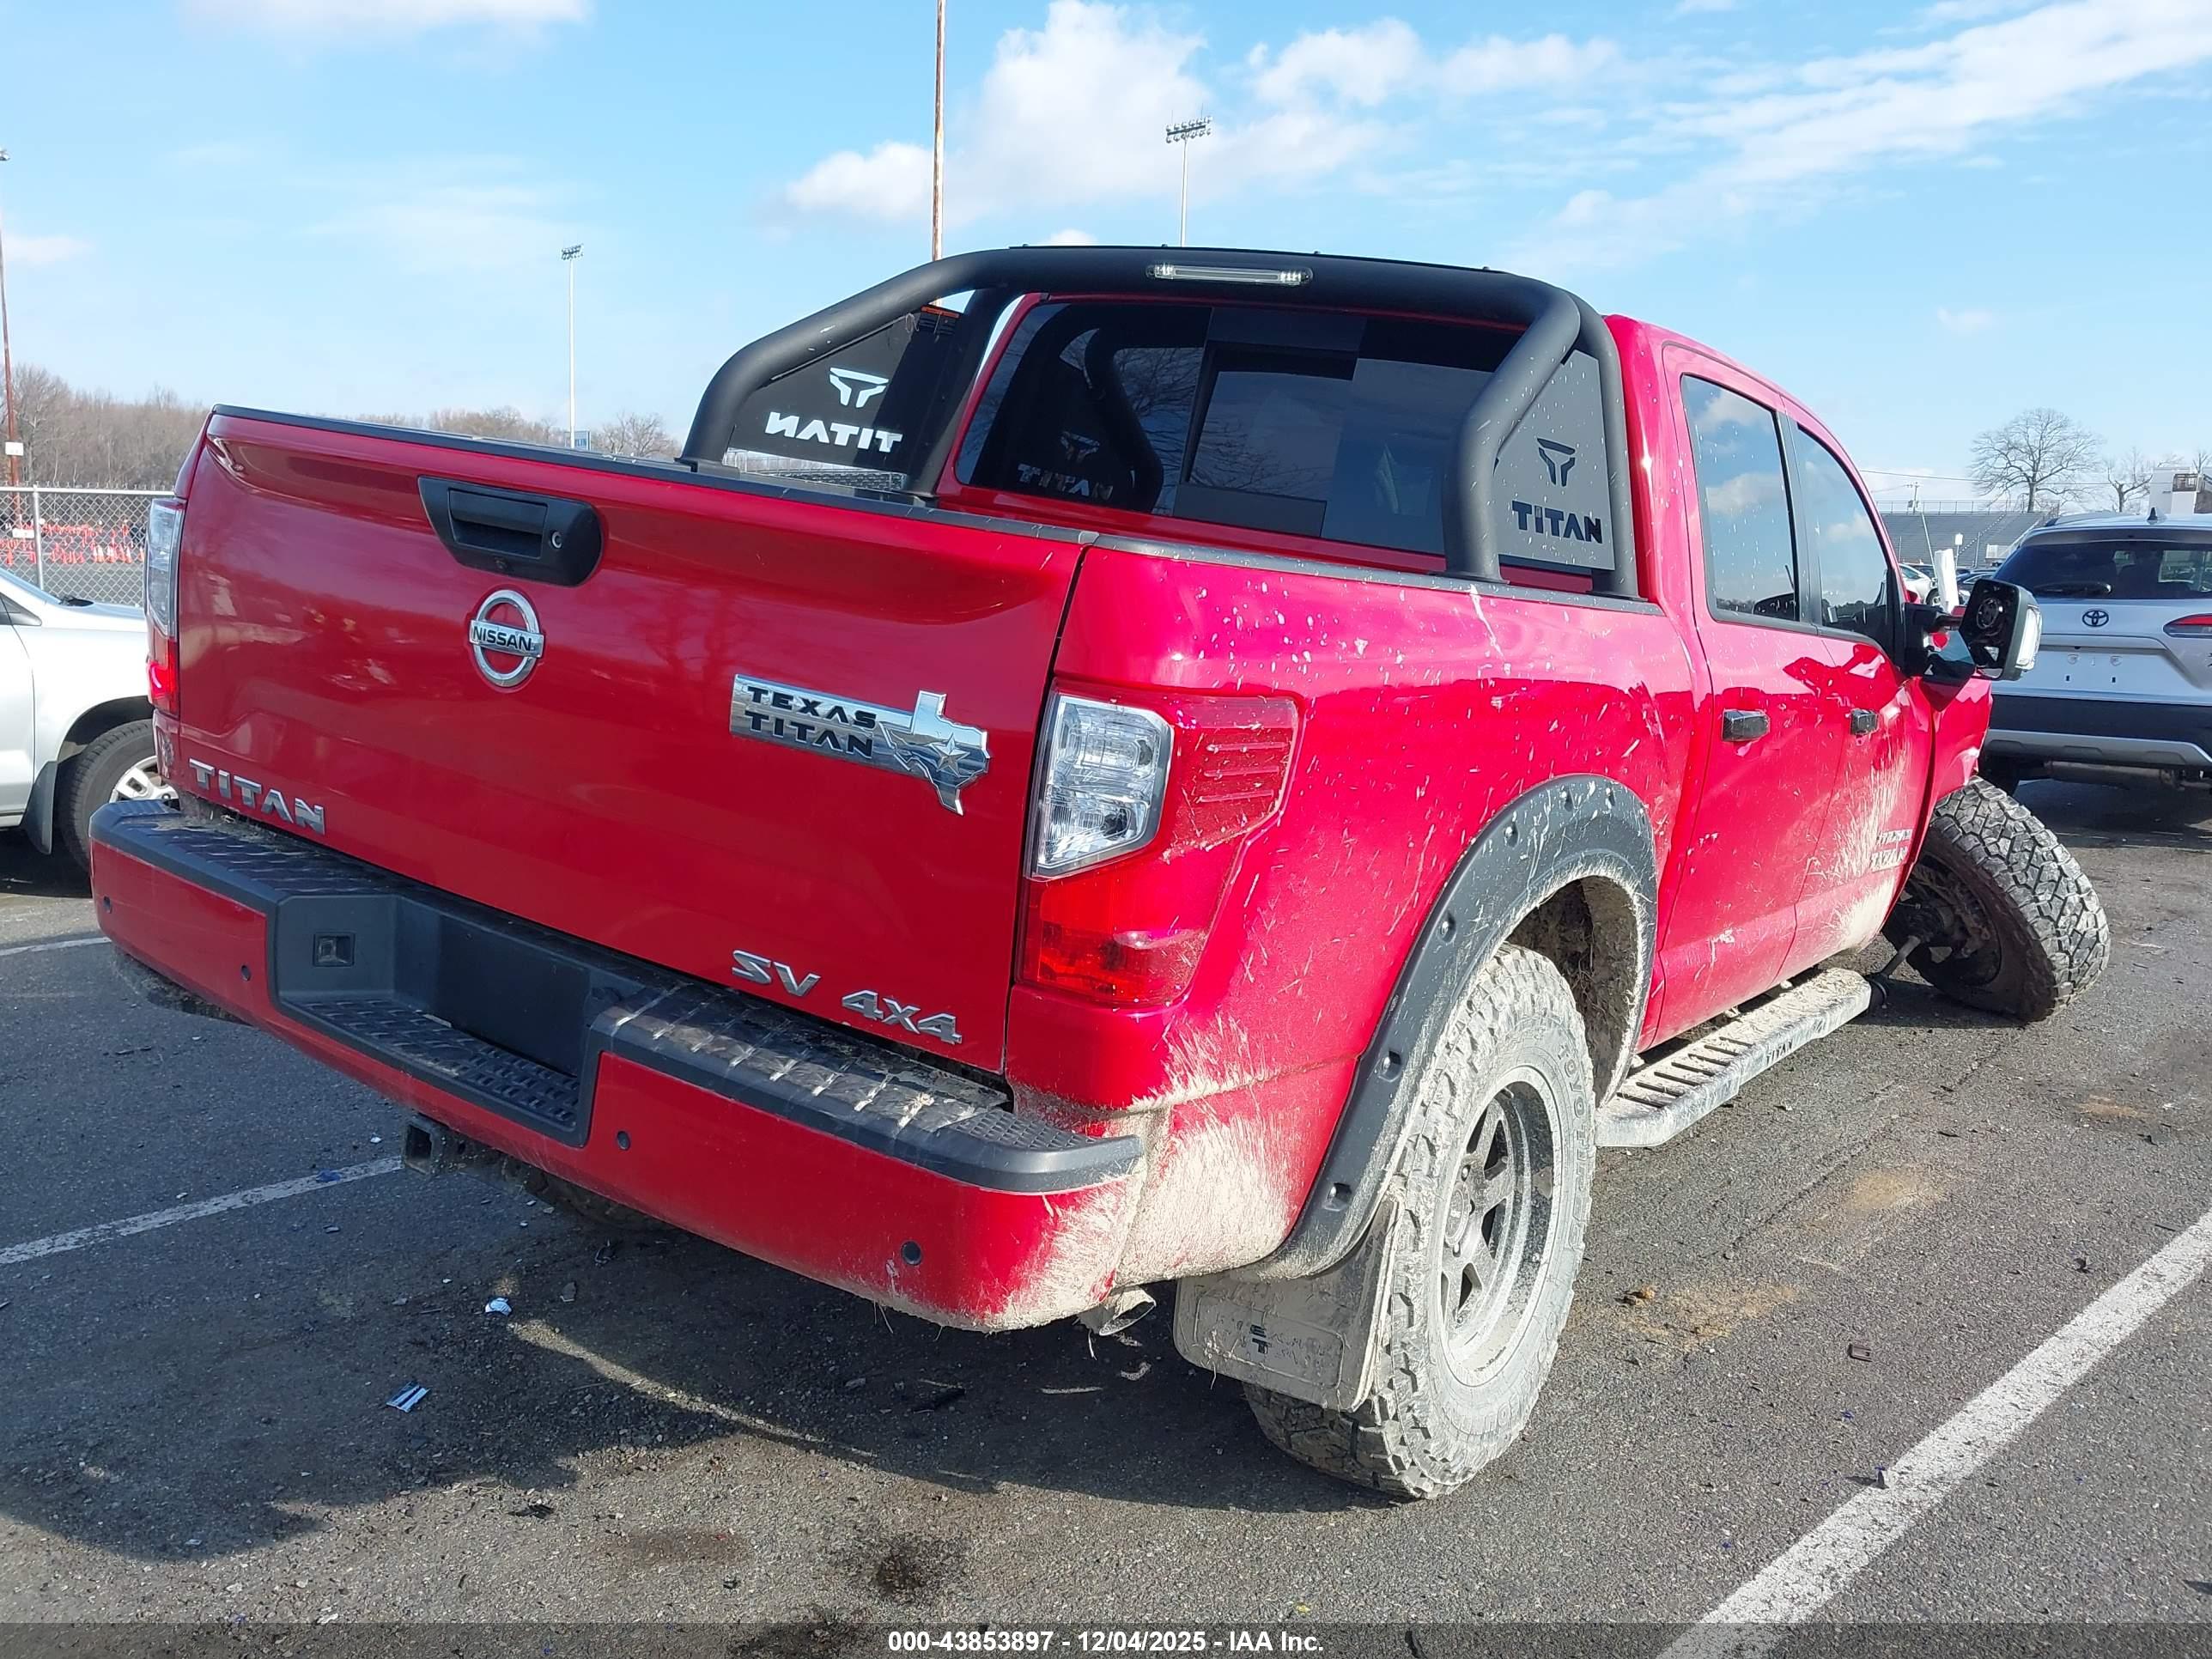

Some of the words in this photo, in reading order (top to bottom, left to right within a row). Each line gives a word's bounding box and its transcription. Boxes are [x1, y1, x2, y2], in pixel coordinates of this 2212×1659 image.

[1511, 500, 1602, 544] TITAN
[472, 625, 532, 651] NISSAN
[747, 686, 877, 729] TEXAS
[744, 710, 873, 759] TITAN
[189, 757, 325, 836] TITAN
[732, 949, 822, 997] SV
